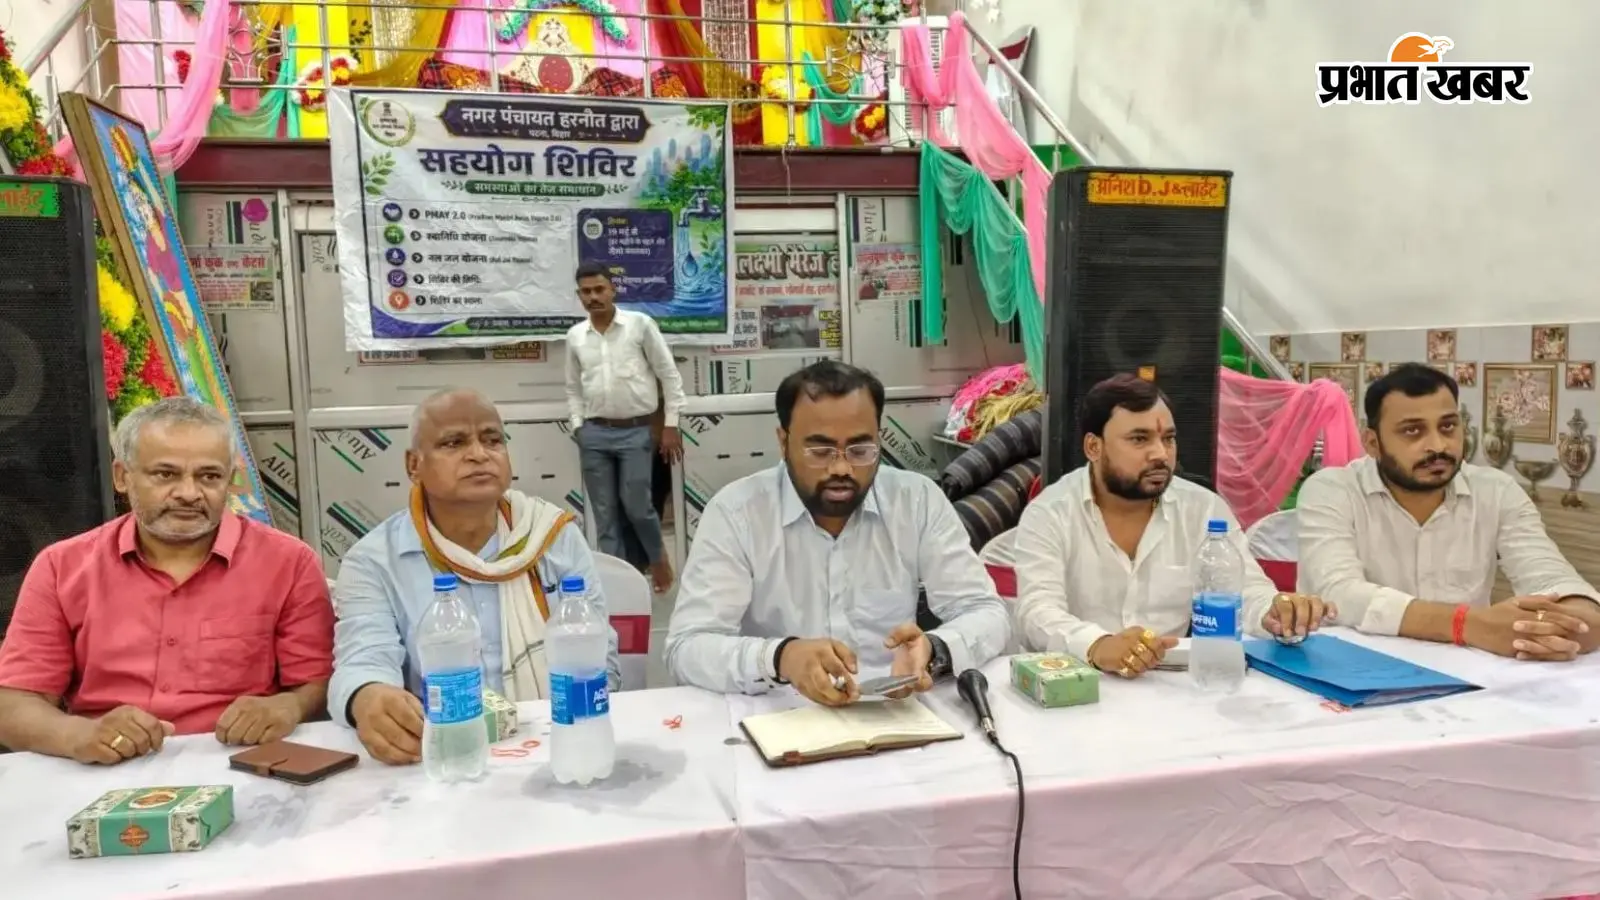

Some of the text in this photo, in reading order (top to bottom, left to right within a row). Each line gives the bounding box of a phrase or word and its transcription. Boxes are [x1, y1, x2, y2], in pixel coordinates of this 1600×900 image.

[461, 107, 495, 124] नगर
[501, 105, 555, 127] पंचायत
[610, 113, 640, 132] द्वारा
[417, 143, 638, 178] सहयोग शिविर
[424, 210, 451, 220] PMAY
[452, 211, 466, 221] 2.0
